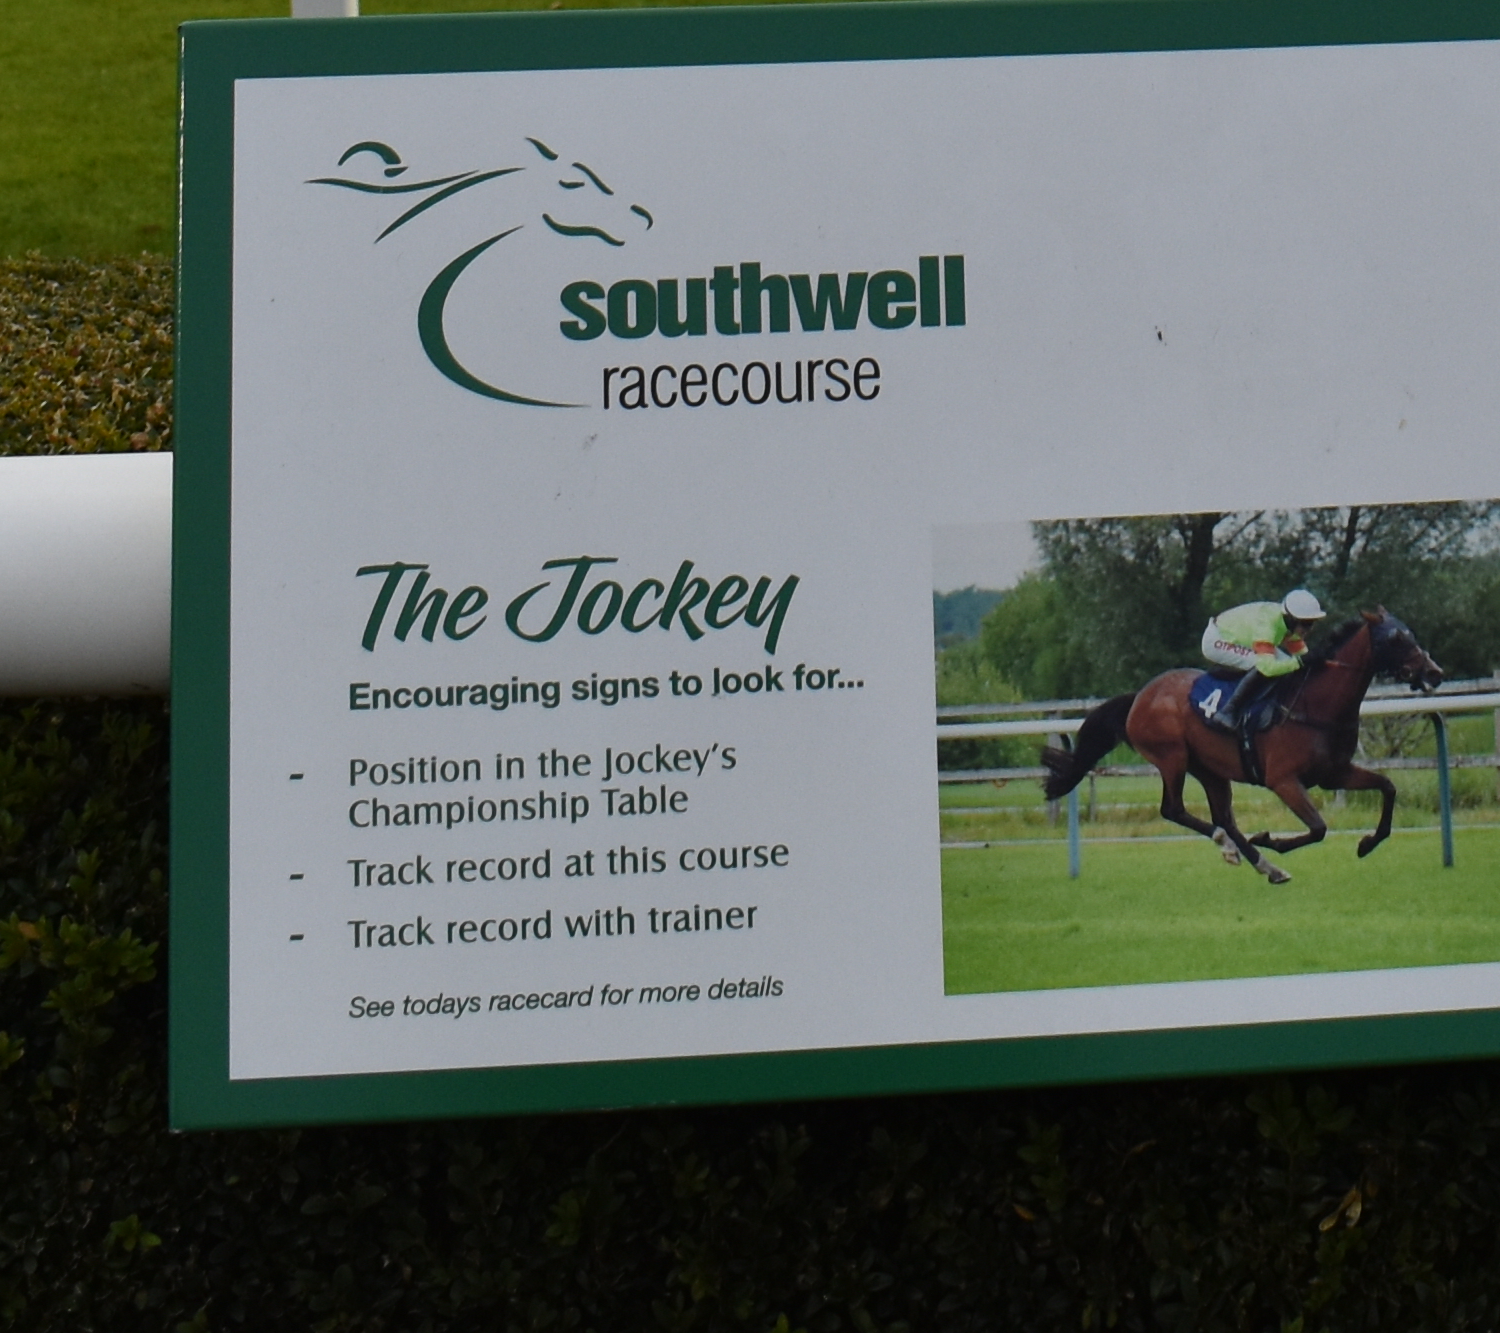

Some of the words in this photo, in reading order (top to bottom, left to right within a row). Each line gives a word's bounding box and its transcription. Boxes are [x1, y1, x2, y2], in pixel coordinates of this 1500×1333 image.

[559, 253, 967, 342] southwell
[602, 356, 881, 411] racecourse
[354, 560, 490, 653] The
[504, 554, 801, 657] Jockey
[348, 675, 561, 712] Encouraging
[571, 671, 661, 707] signs
[667, 669, 703, 697] to
[710, 663, 786, 698] look
[791, 662, 865, 692] for...
[1197, 687, 1223, 719] 4
[349, 755, 482, 788] Position
[495, 752, 525, 781] in
[536, 747, 592, 779] the
[600, 742, 737, 783] Jockey's
[348, 789, 590, 831] Championship
[599, 783, 689, 818] Table
[346, 854, 435, 888] Track
[446, 848, 552, 884] record
[563, 849, 596, 879] at
[605, 844, 667, 877] this
[678, 843, 790, 873] course
[346, 914, 436, 949] Track
[446, 908, 553, 945] record
[563, 905, 636, 939] with
[646, 903, 759, 935] trainer
[348, 995, 396, 1019] See
[402, 991, 482, 1020] todays
[487, 984, 595, 1013] racecard
[600, 983, 635, 1007] for
[638, 984, 701, 1005] more
[707, 974, 785, 1001] details
